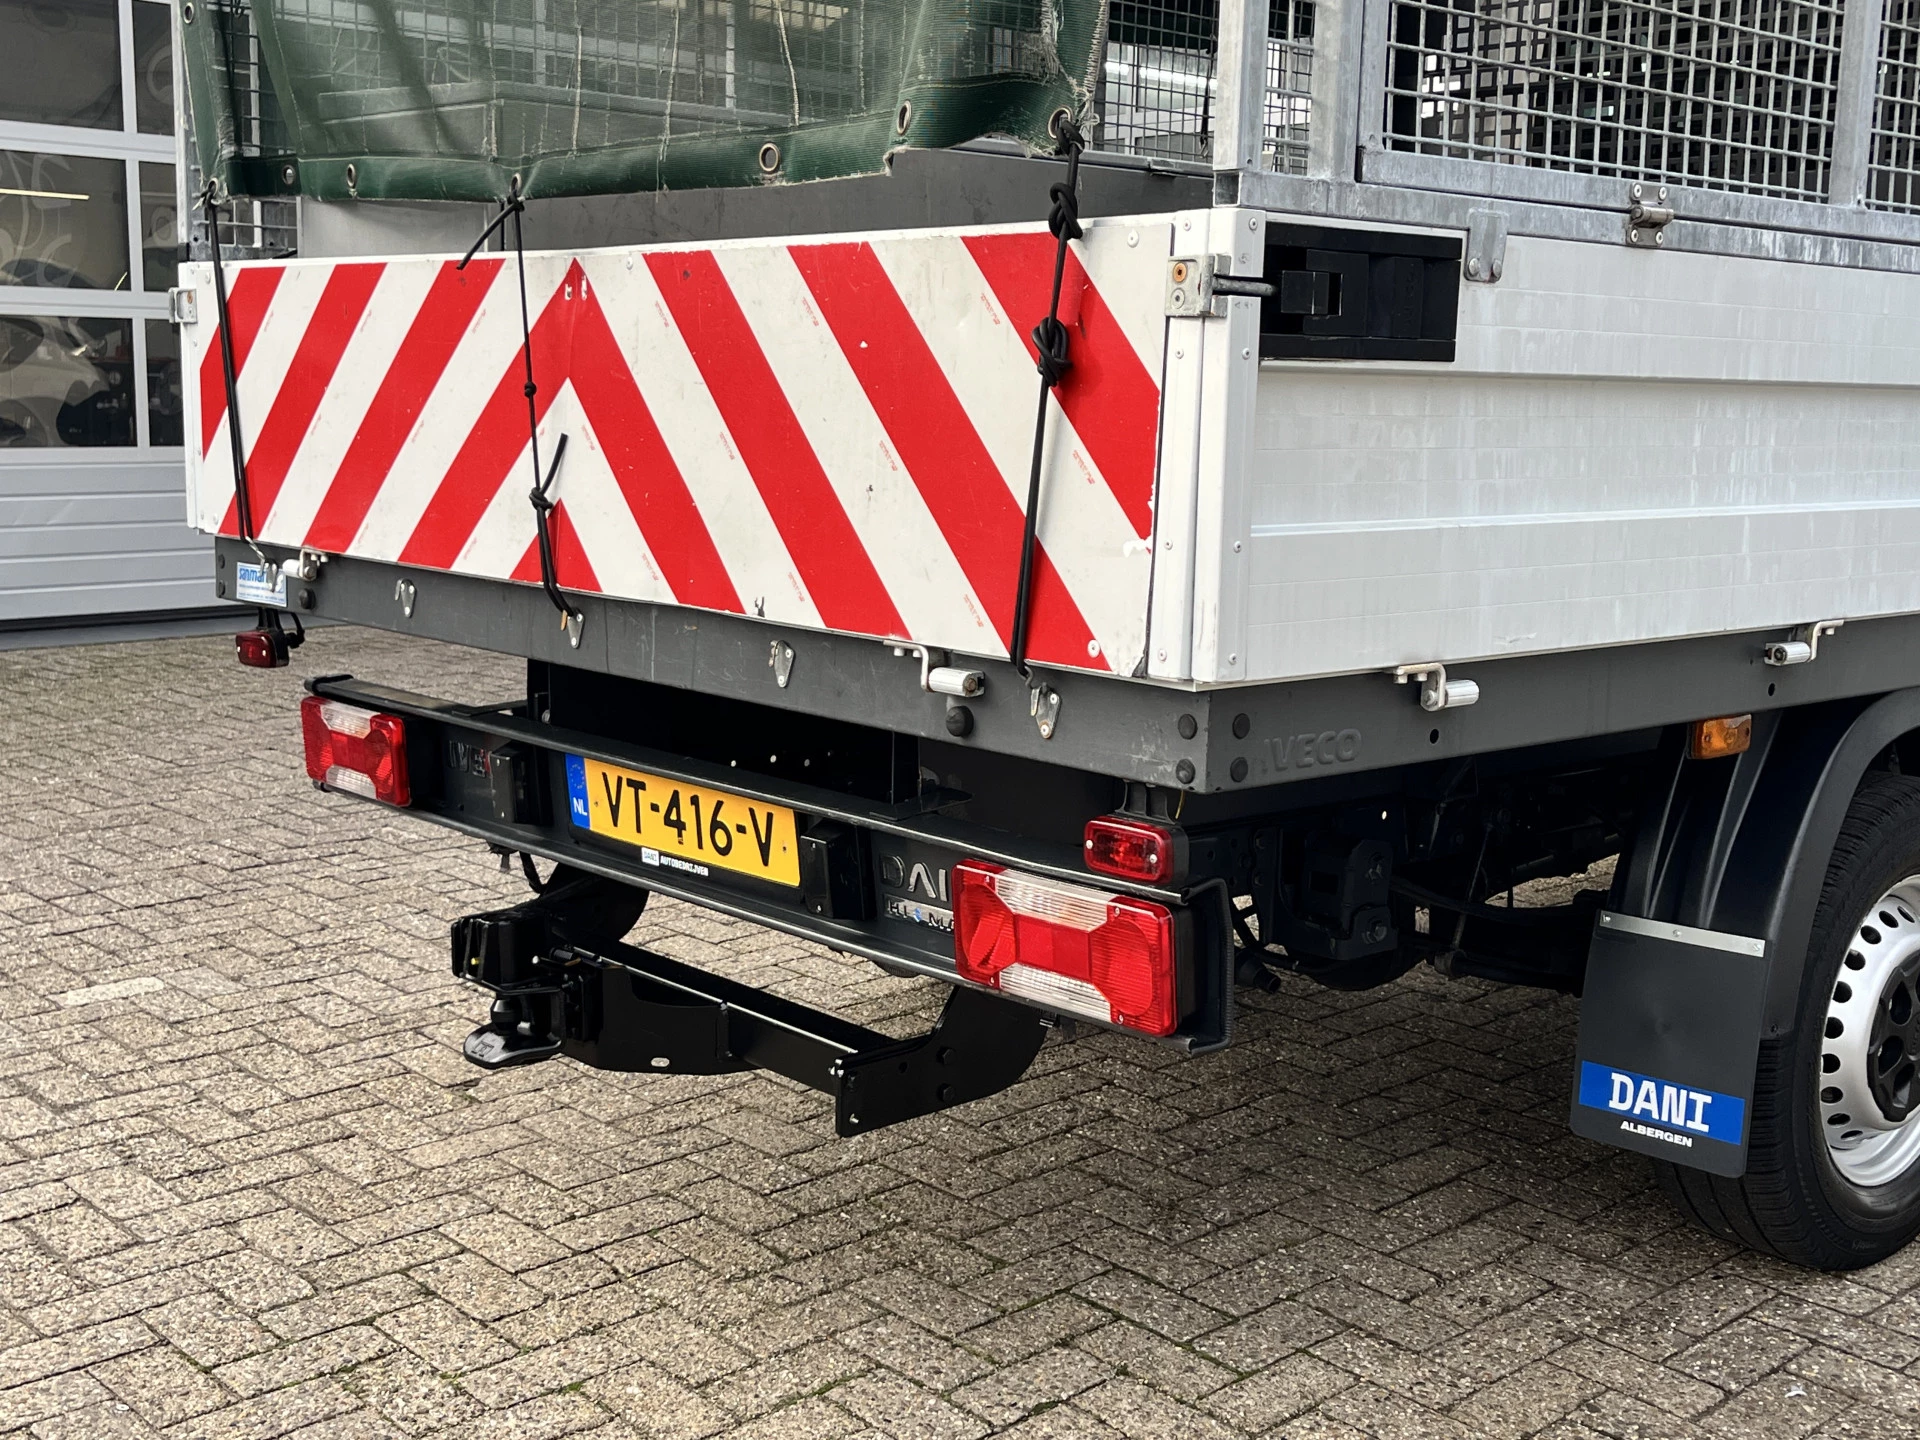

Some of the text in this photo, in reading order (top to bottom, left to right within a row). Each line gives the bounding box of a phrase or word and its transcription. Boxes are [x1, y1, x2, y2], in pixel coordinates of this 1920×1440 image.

[1262, 728, 1362, 774] IVECO
[573, 797, 588, 816] NL
[602, 771, 774, 867] VT-416-V
[660, 855, 709, 877] AUTOBEDRIJVEN
[1608, 1072, 1712, 1133] DANI
[1620, 1120, 1693, 1148] ALBERGEN
